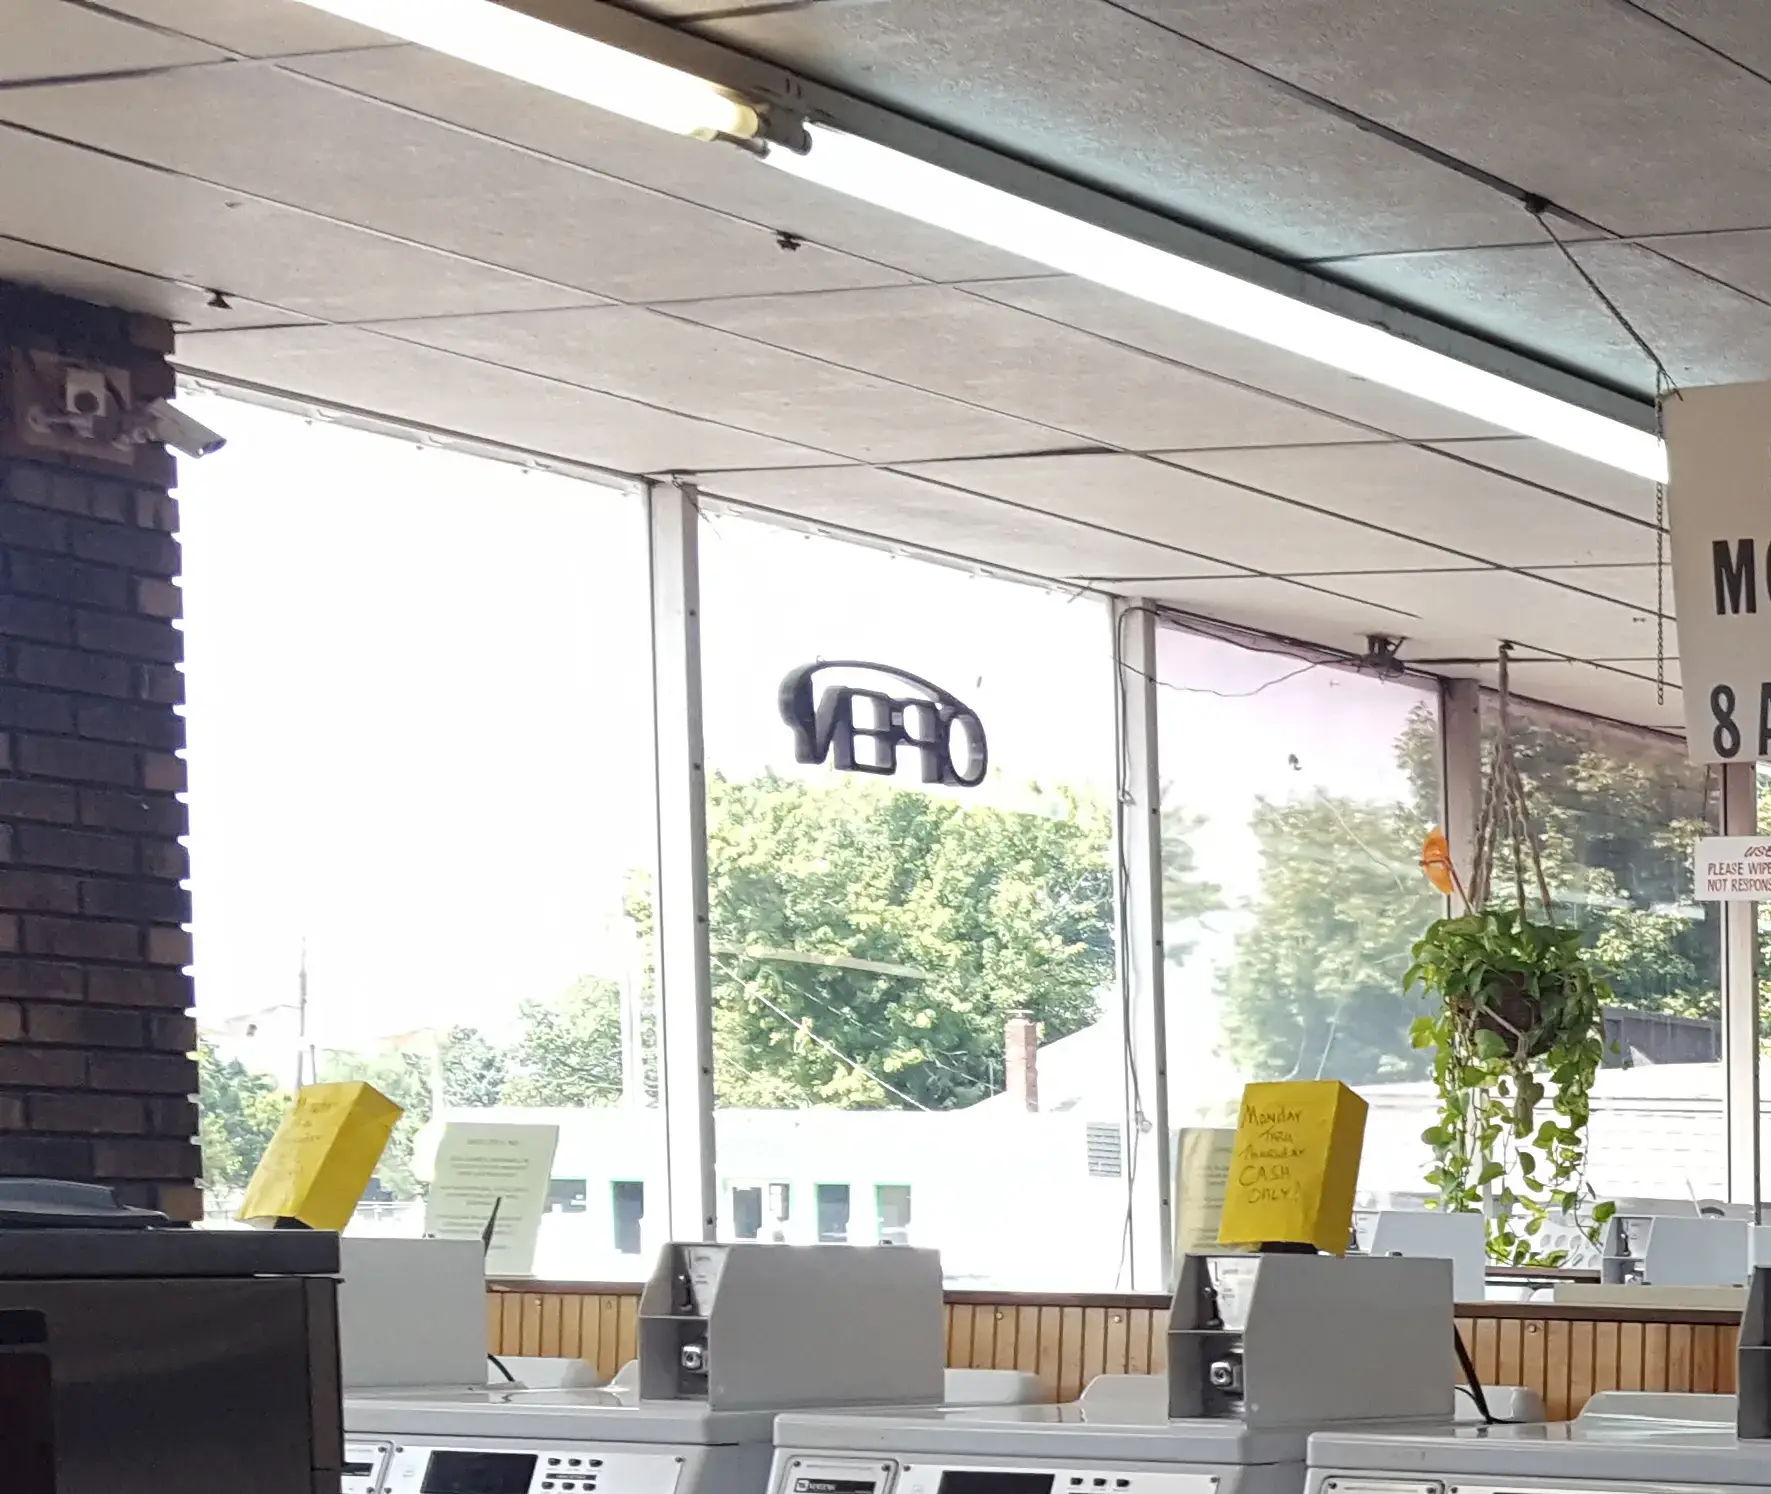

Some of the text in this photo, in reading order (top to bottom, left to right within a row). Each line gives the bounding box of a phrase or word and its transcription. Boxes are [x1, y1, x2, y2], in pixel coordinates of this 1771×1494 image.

[1710, 684, 1741, 758] 8
[1707, 862, 1744, 876] PLEASE
[1707, 879, 1728, 893] NOT
[1239, 1164, 1291, 1186] CASH
